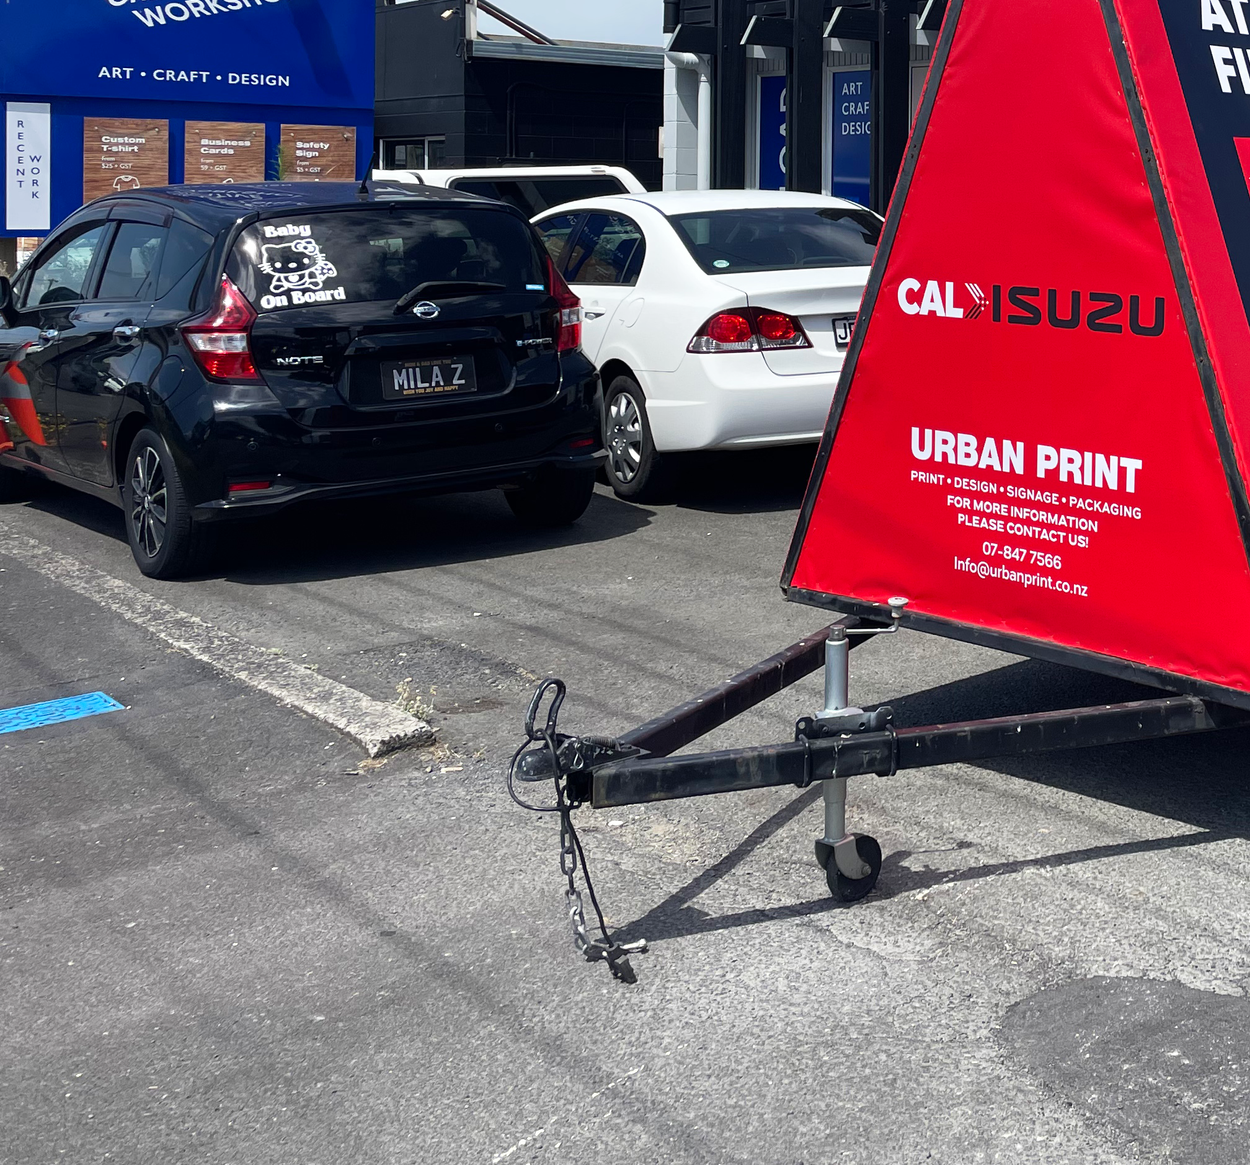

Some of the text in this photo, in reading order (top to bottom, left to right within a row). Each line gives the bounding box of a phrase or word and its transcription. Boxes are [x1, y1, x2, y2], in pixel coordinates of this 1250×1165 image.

[98, 66, 290, 87] ART CRAFT DESIGN
[842, 82, 863, 96] ART
[842, 102, 869, 115] CRAF
[101, 136, 146, 144] Custom
[101, 144, 139, 153] T-shirt
[201, 139, 250, 147] Business
[296, 142, 330, 150] Safety
[16, 120, 25, 188] RECENT
[296, 150, 319, 158] Sign
[29, 155, 42, 199] WORK
[264, 223, 312, 238] Baby
[260, 286, 346, 309] On Board
[897, 278, 1165, 337] CAL ISUZU
[277, 355, 323, 366] NOTE
[392, 366, 444, 390] MILA
[451, 364, 466, 384] Z
[911, 426, 1142, 493] URBAN PRINT
[910, 470, 1142, 519] PRINT DESIGN SIGNAGE PACKAGING
[947, 495, 1098, 532] FOR MORE INFORMATION
[957, 513, 1089, 548] PLEASE CONTACT US!
[982, 541, 1062, 570] 07-847 7566
[954, 556, 1088, 597] Info@urbanprint.co.nz
